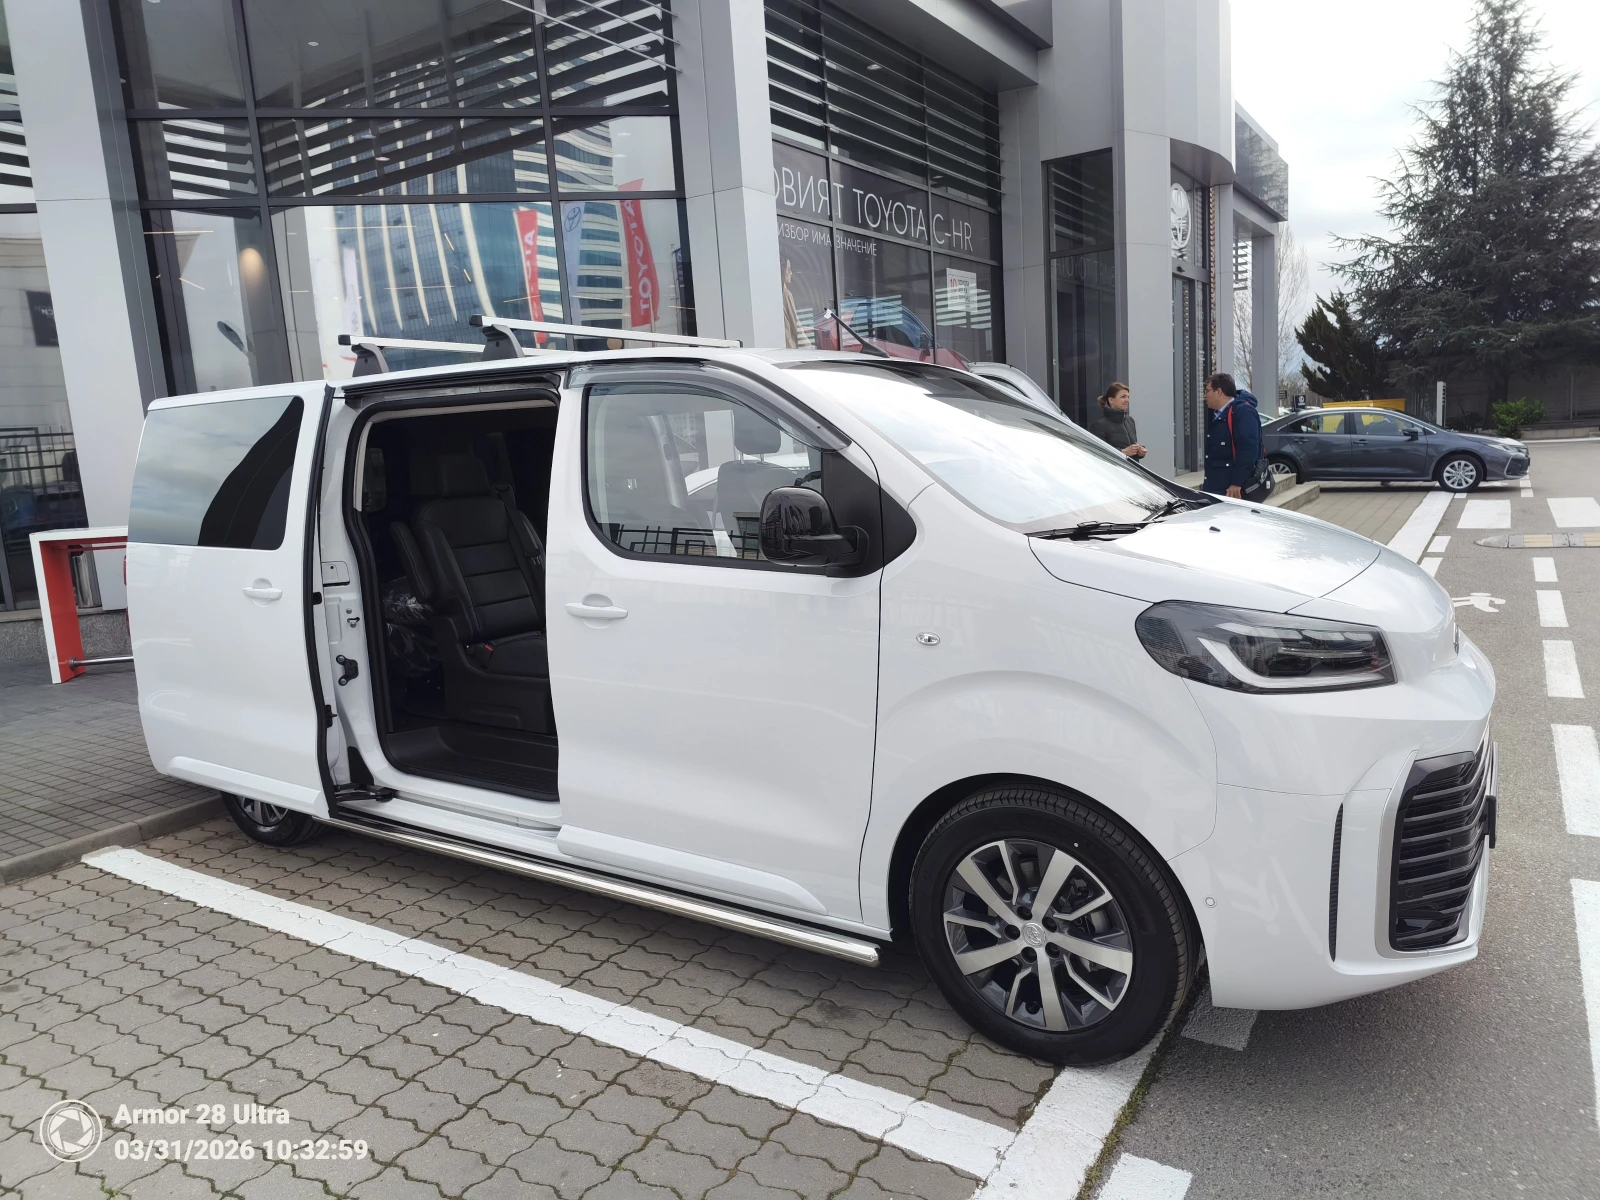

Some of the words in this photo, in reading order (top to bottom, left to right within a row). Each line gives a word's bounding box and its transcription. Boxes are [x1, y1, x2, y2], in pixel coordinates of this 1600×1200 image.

[811, 230, 832, 248] ИМА
[835, 235, 877, 256] ЗНАЧЕНИЕ
[852, 188, 928, 241] TOYOTA
[933, 213, 974, 252] C-HR
[624, 199, 652, 316] TOYOTA
